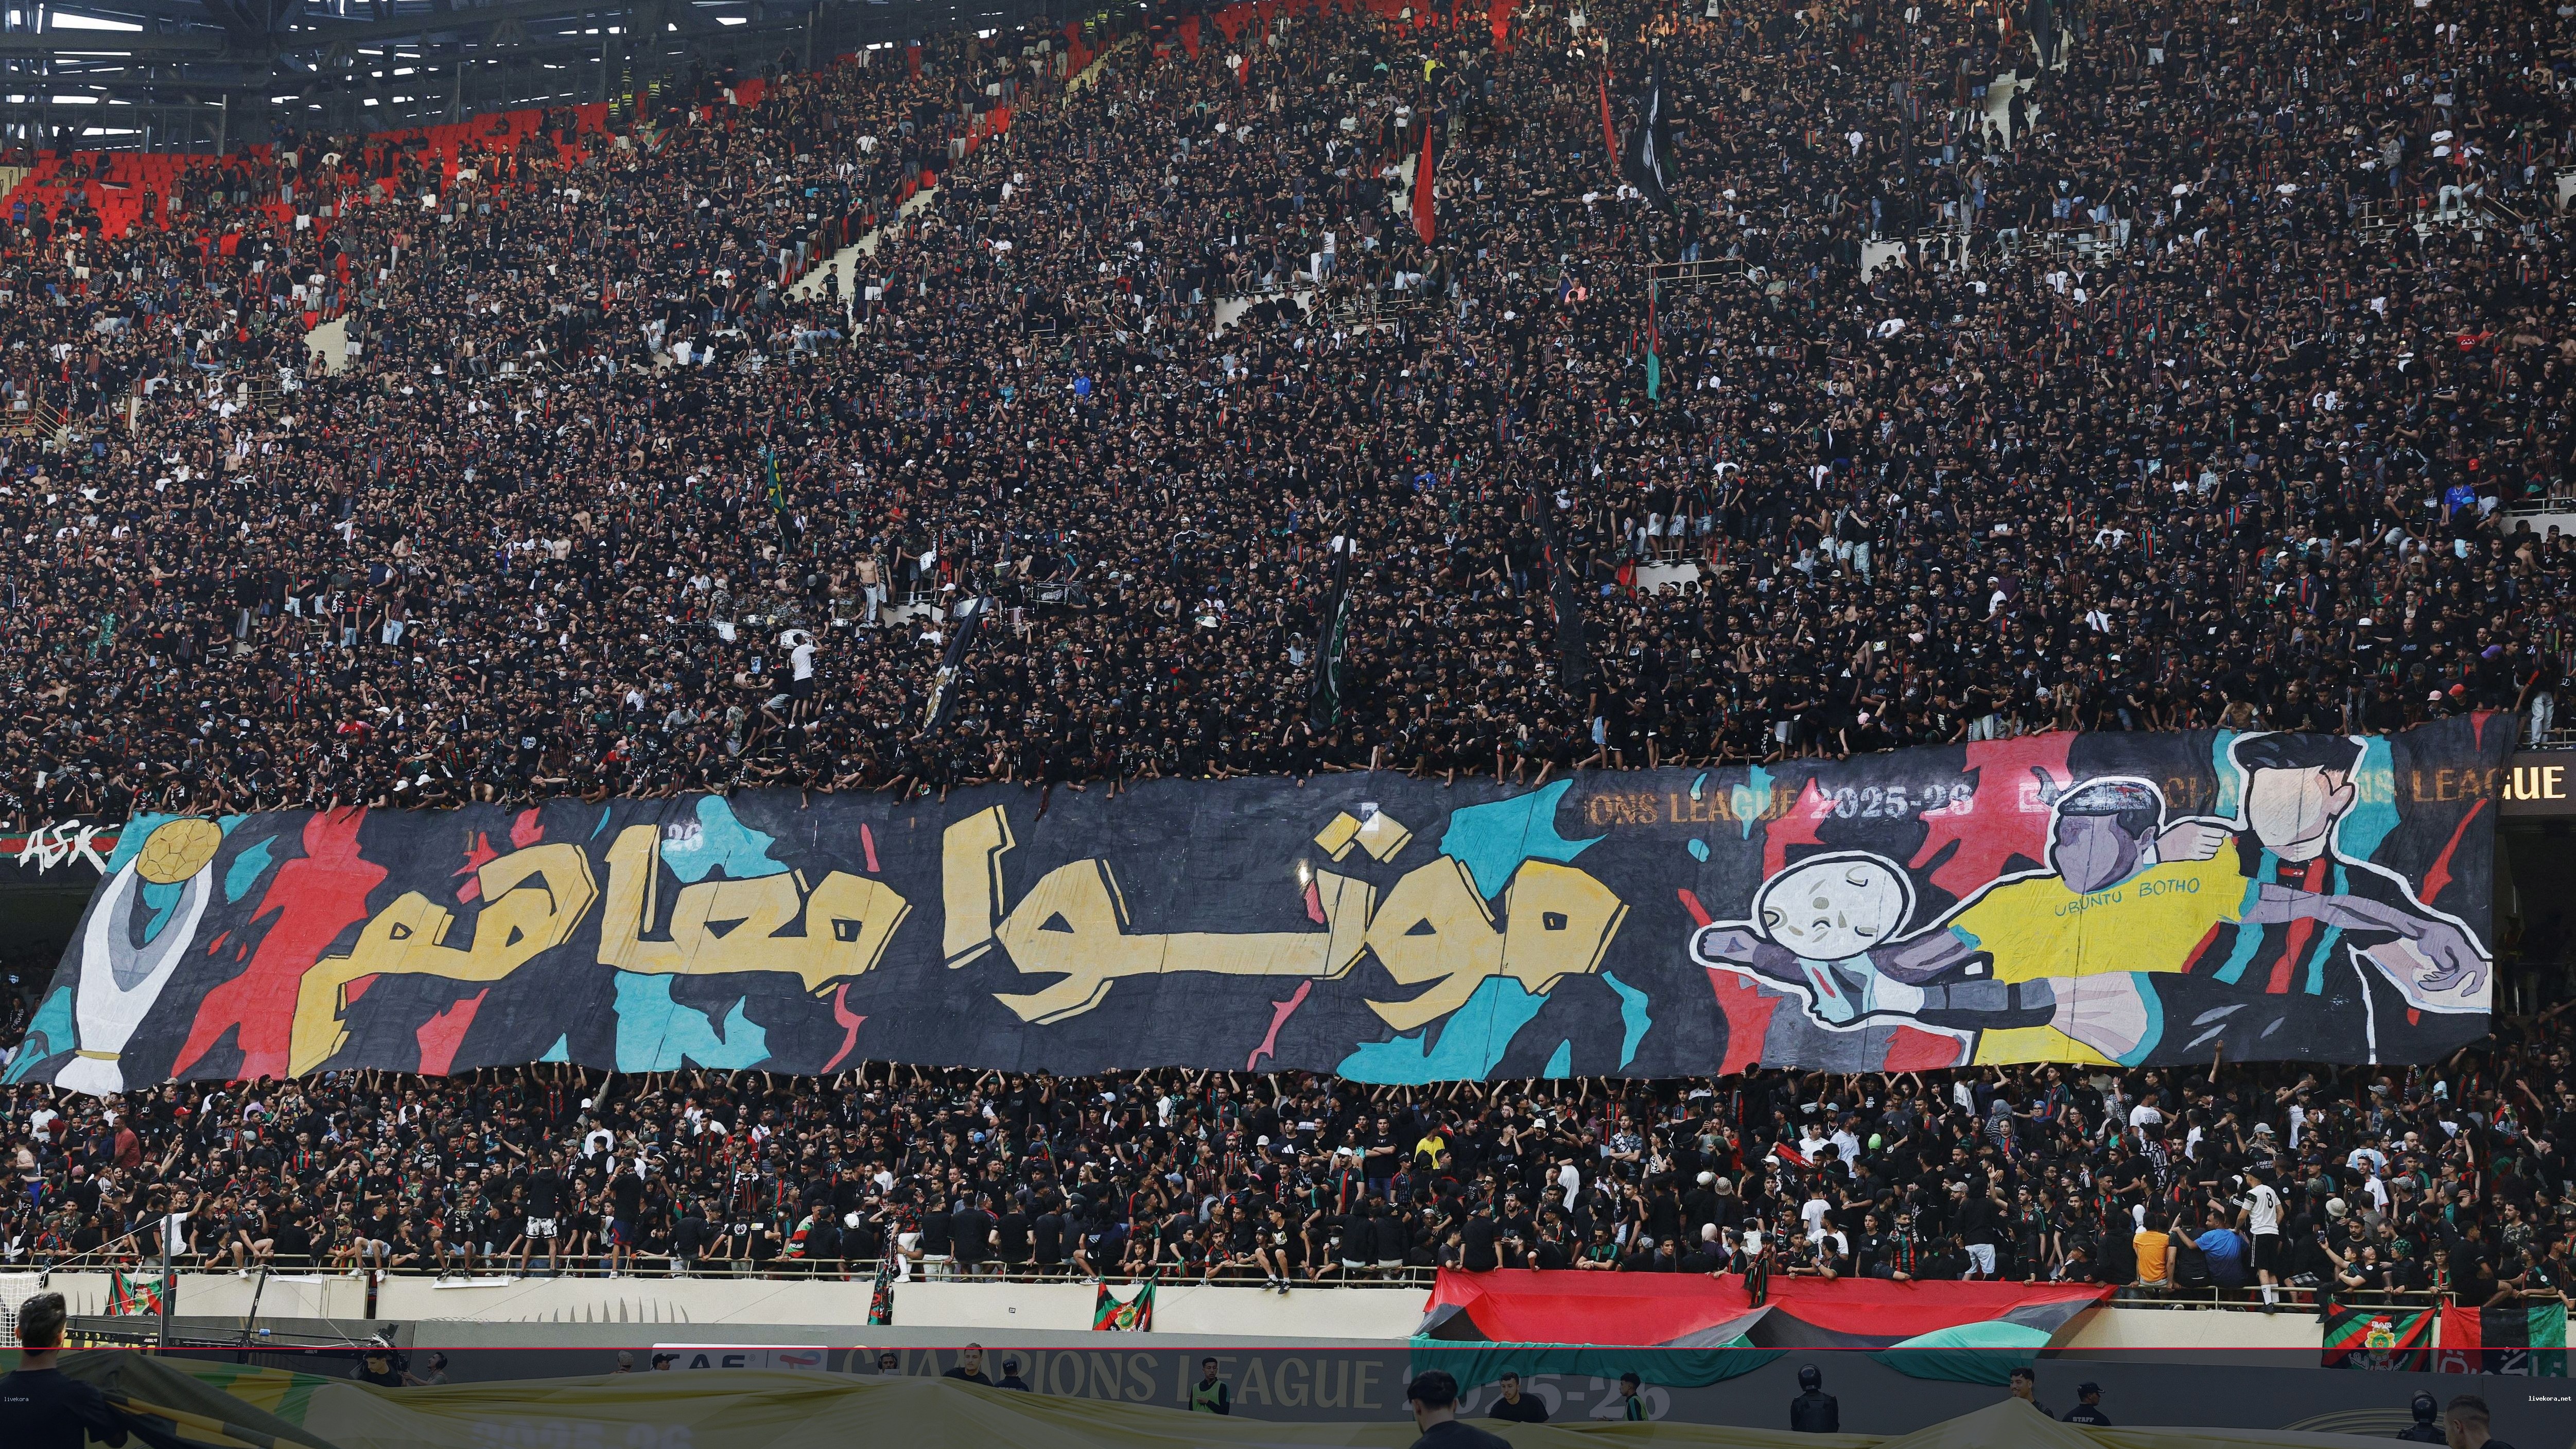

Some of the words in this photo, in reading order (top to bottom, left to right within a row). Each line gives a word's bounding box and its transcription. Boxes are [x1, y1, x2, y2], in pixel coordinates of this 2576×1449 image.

[1585, 793, 1658, 826] ONS
[1670, 789, 1798, 823] LEAGUE
[1809, 783, 1974, 819] 2025-26
[14, 819, 120, 876] ASK
[2055, 891, 2122, 917] UBUNTU
[2139, 877, 2201, 898] BOTHO
[2266, 1192, 2273, 1209] 8
